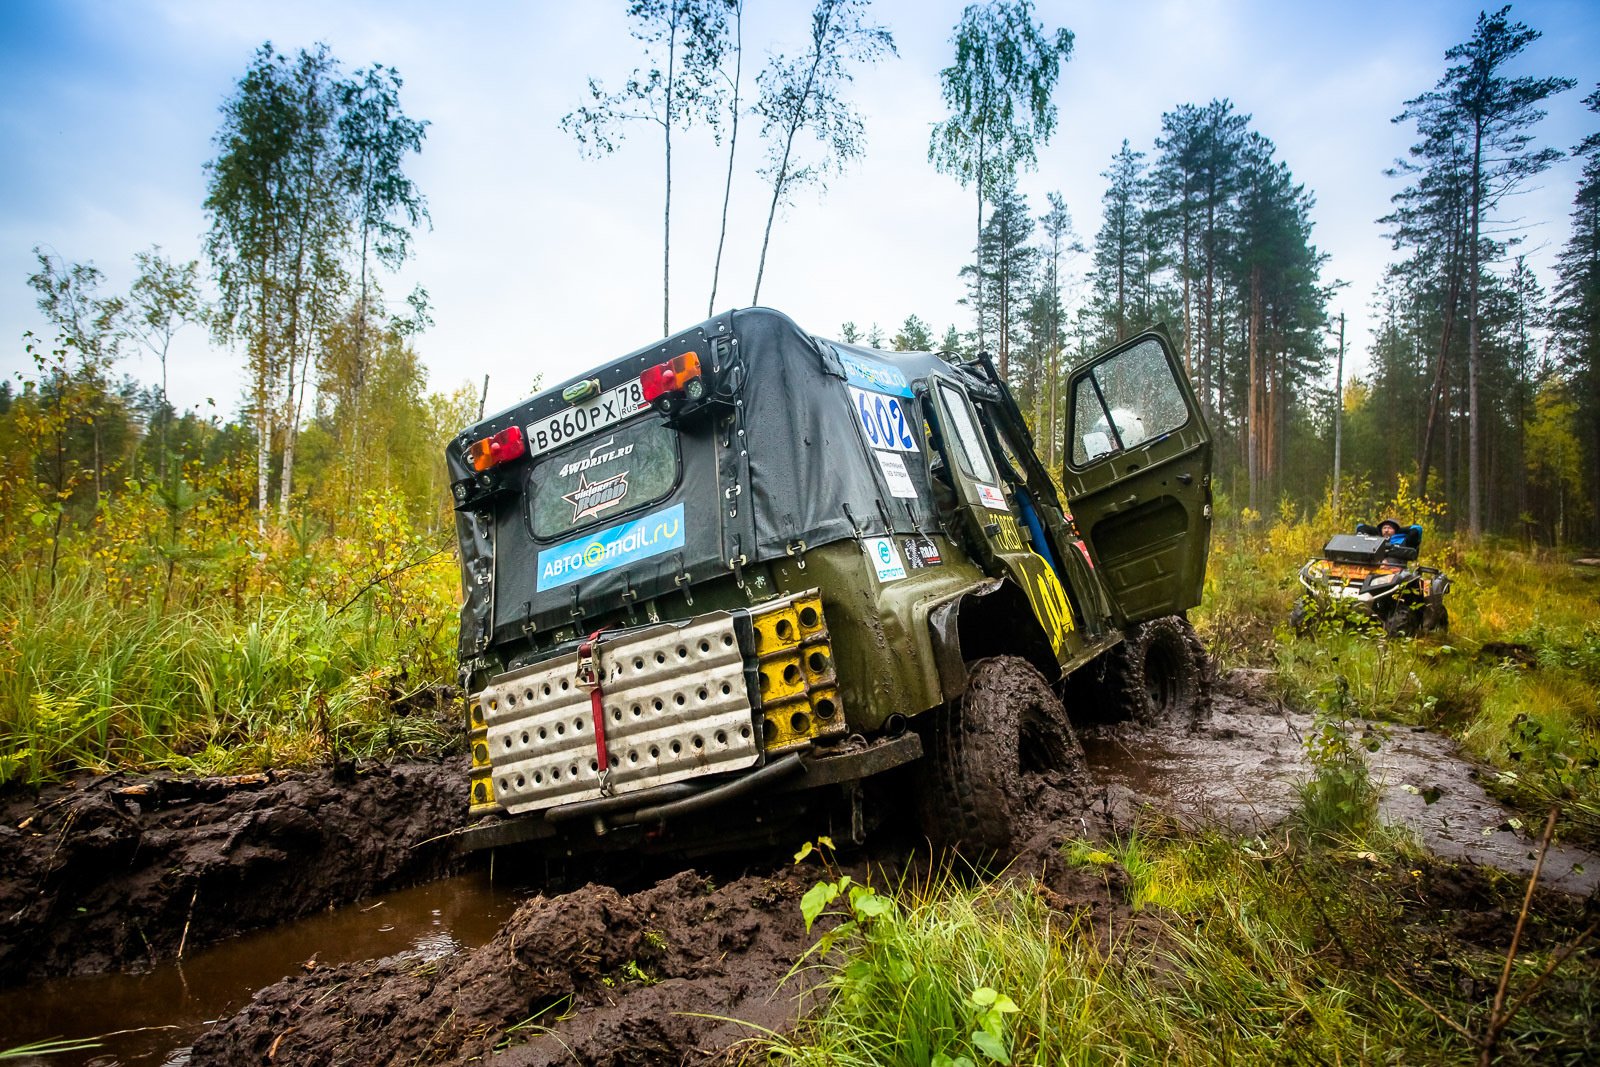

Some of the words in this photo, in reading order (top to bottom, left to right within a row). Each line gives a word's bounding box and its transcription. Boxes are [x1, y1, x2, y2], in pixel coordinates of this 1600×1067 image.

[618, 383, 642, 408] 78
[621, 403, 638, 416] RUS
[858, 393, 913, 449] 602
[559, 444, 634, 478] 4WDRIVE.RU
[543, 518, 679, 580] АВТО@mail.ru
